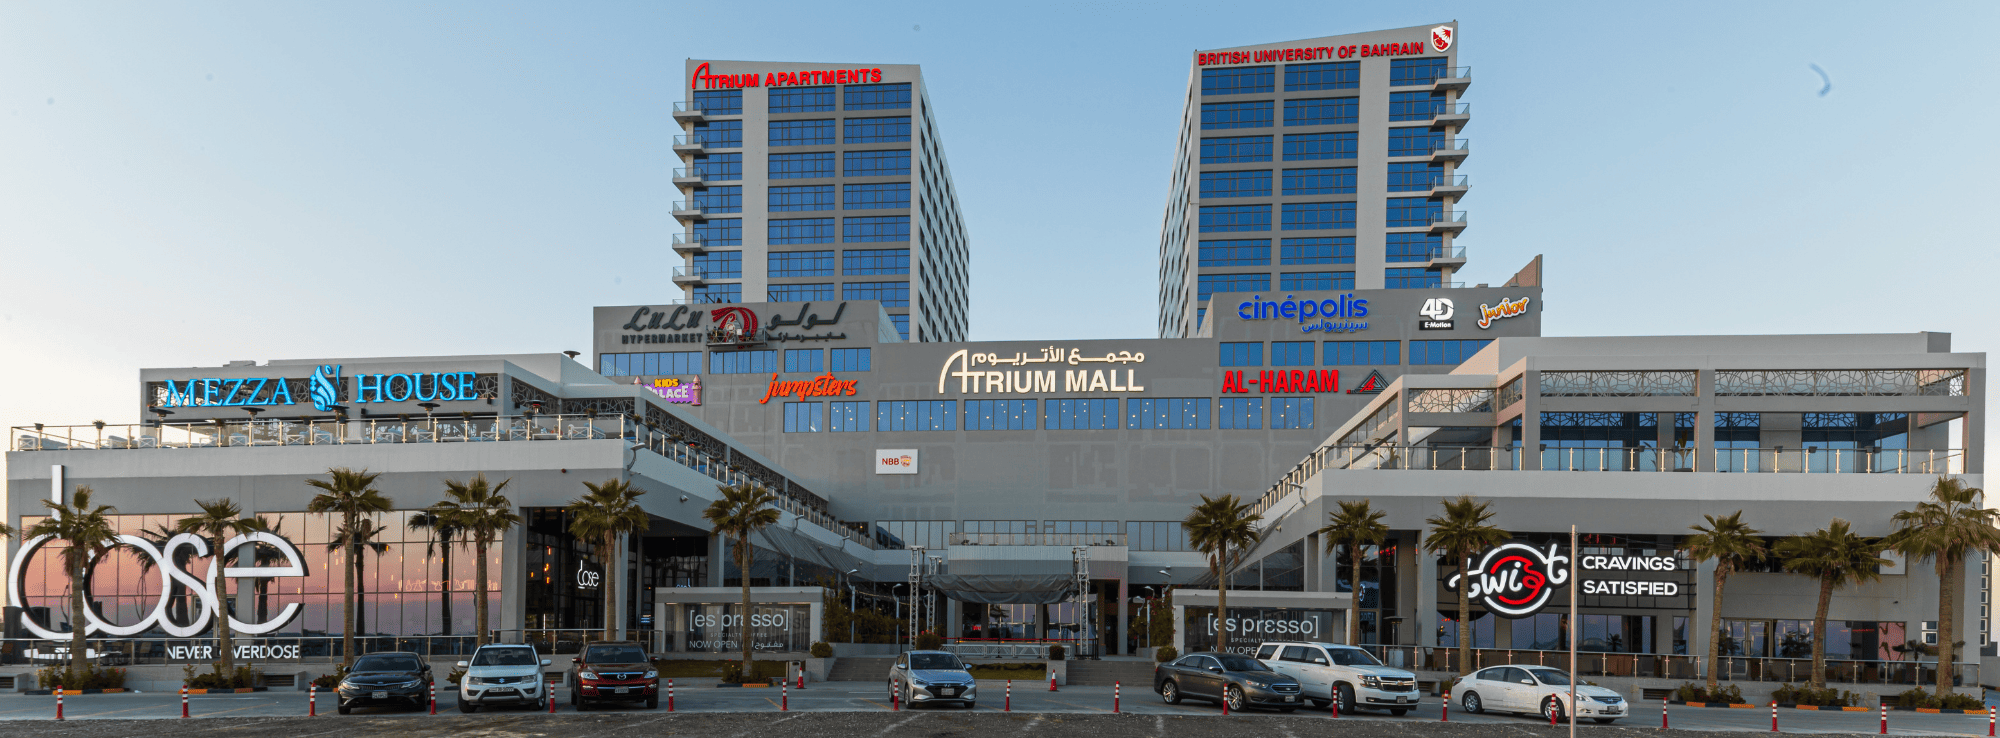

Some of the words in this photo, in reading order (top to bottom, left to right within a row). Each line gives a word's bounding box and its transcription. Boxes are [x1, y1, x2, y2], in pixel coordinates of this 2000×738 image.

[1198, 51, 1250, 66] BRITISH
[1254, 46, 1334, 63] UNIVERSITY
[1338, 45, 1357, 58] OF
[1361, 41, 1424, 57] BAHRAIN
[691, 62, 759, 89] ATRIUM
[764, 68, 882, 87] APARTMENTS
[766, 302, 847, 330] لولو
[1238, 293, 1368, 323] cinépolis
[1420, 298, 1454, 320] 4D
[1478, 298, 1528, 328] junior
[621, 333, 703, 344] HYPERMARKET
[971, 346, 1065, 366] الأتريوم
[1068, 348, 1145, 365] مجمع
[938, 349, 1056, 394] ATRIUM
[1065, 369, 1144, 392] MALL
[1222, 369, 1339, 393] AL-HARAM
[164, 377, 295, 407] MEZZA
[355, 371, 478, 403] HOUSE
[654, 378, 679, 388] KIDS
[759, 372, 858, 404] jumpsters
[1582, 556, 1676, 571] CRAVINGS
[1583, 580, 1678, 595] SATISFIED
[167, 645, 213, 659] NEVER
[219, 645, 301, 659] VERDOSE
[689, 640, 712, 648] NOW
[713, 640, 738, 648] OPEN
[1210, 645, 1236, 654] NW
